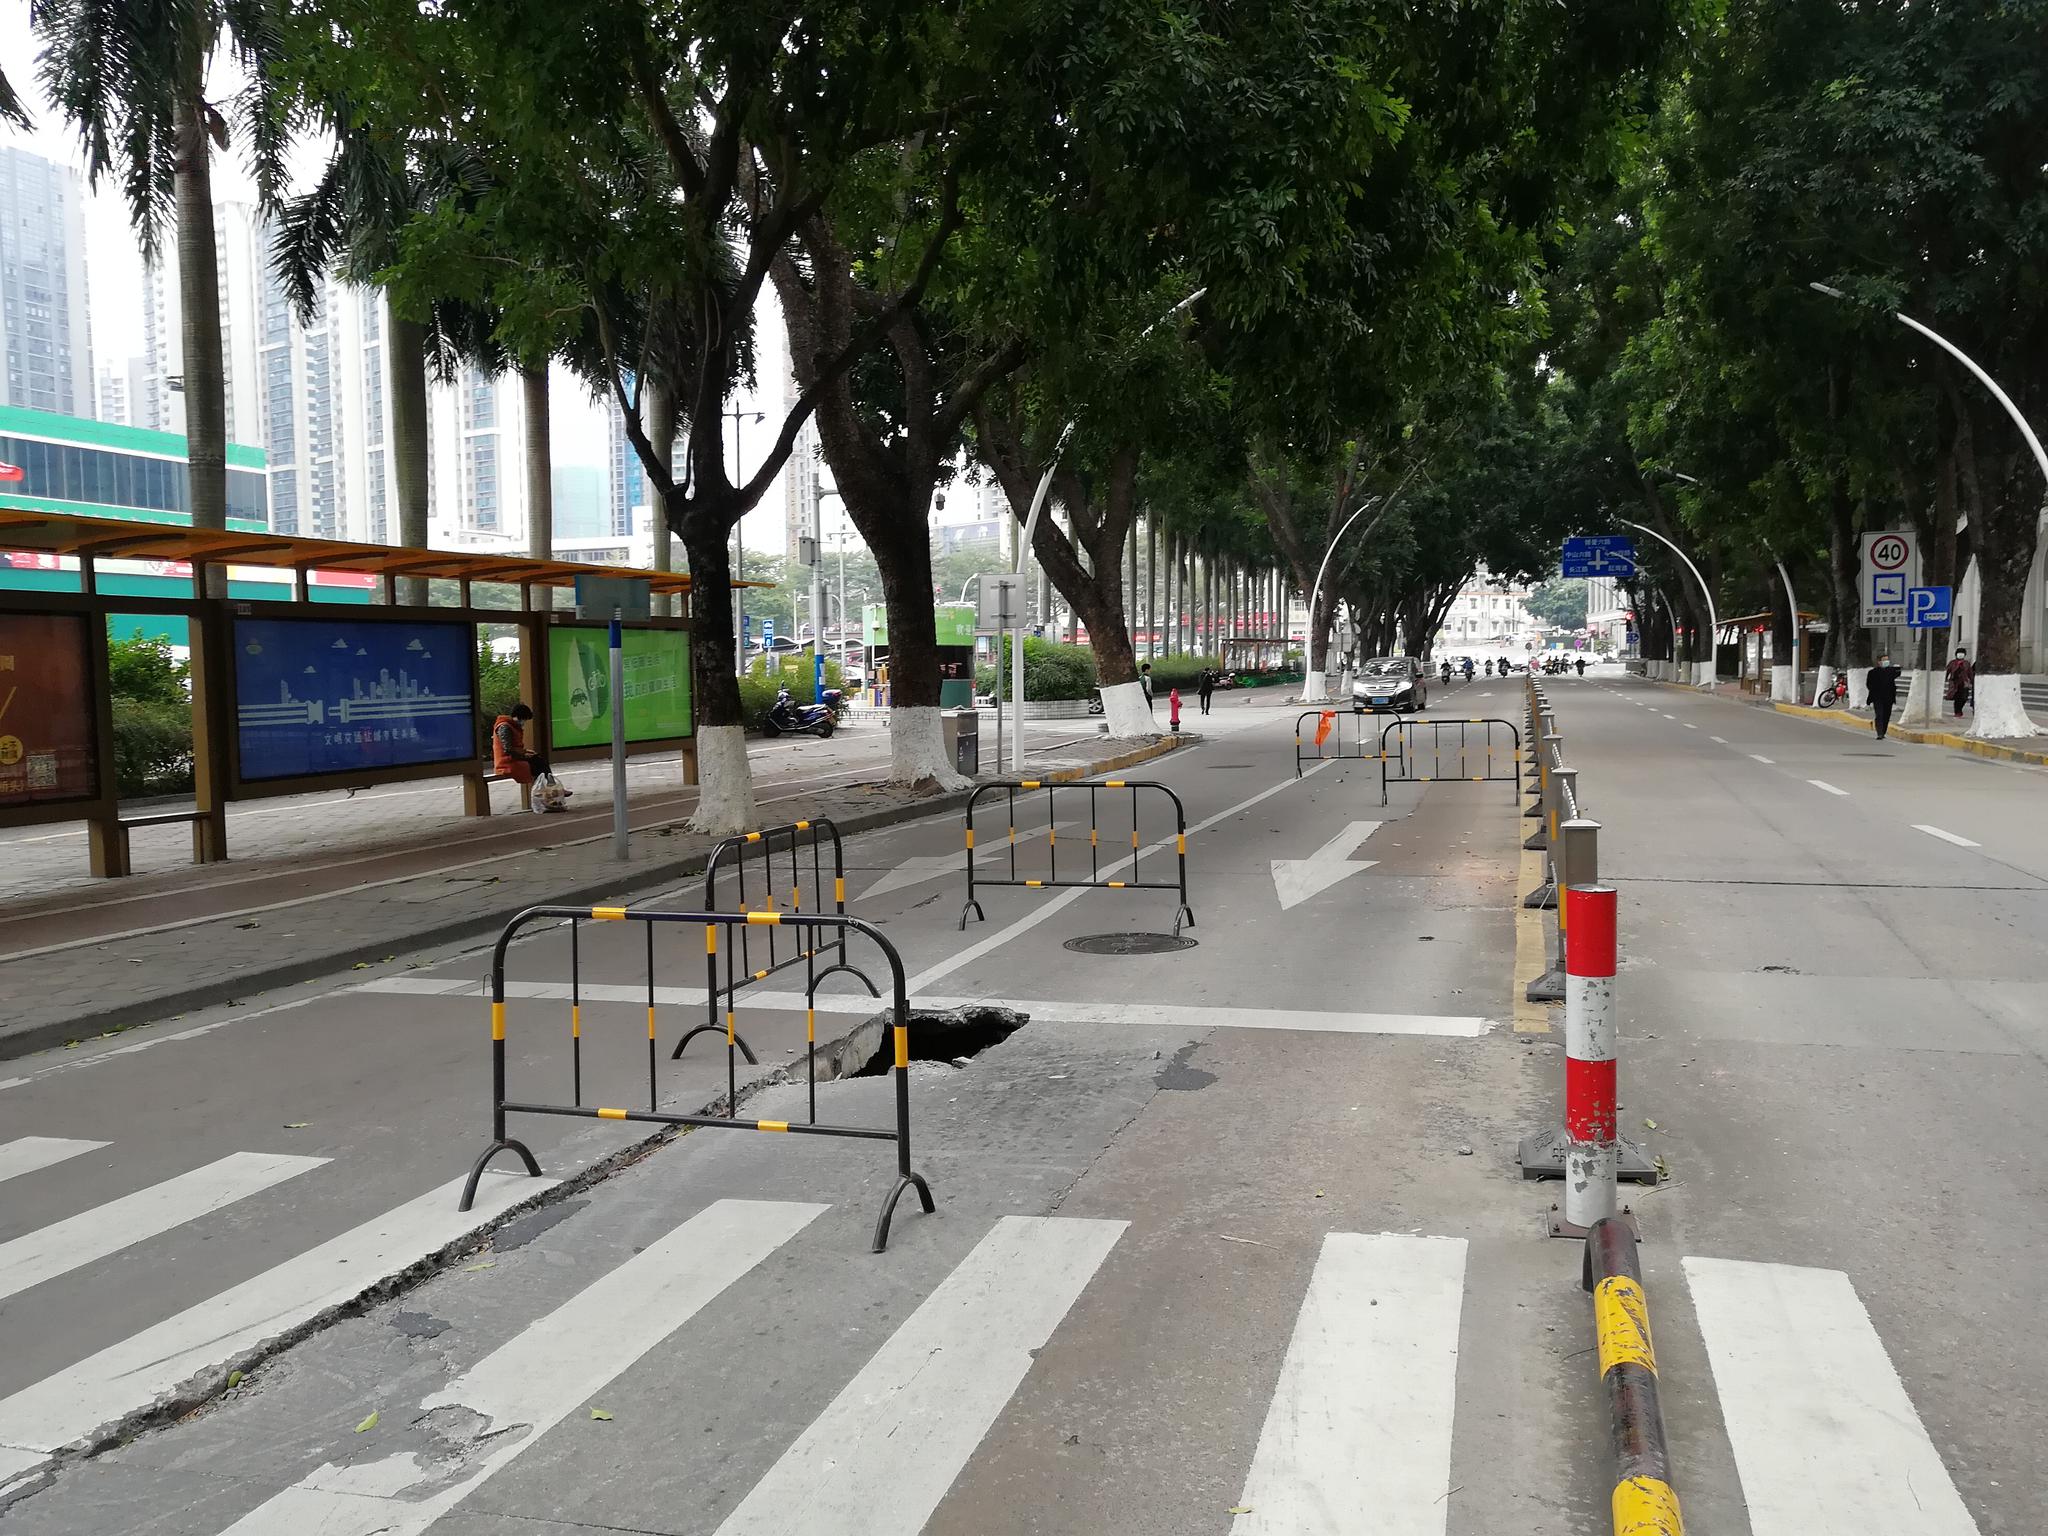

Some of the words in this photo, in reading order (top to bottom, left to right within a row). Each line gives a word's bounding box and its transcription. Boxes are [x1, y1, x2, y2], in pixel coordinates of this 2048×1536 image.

[1878, 544, 1901, 561] 40
[1866, 607, 1908, 615] 交通技术监
[1910, 590, 1936, 625] P
